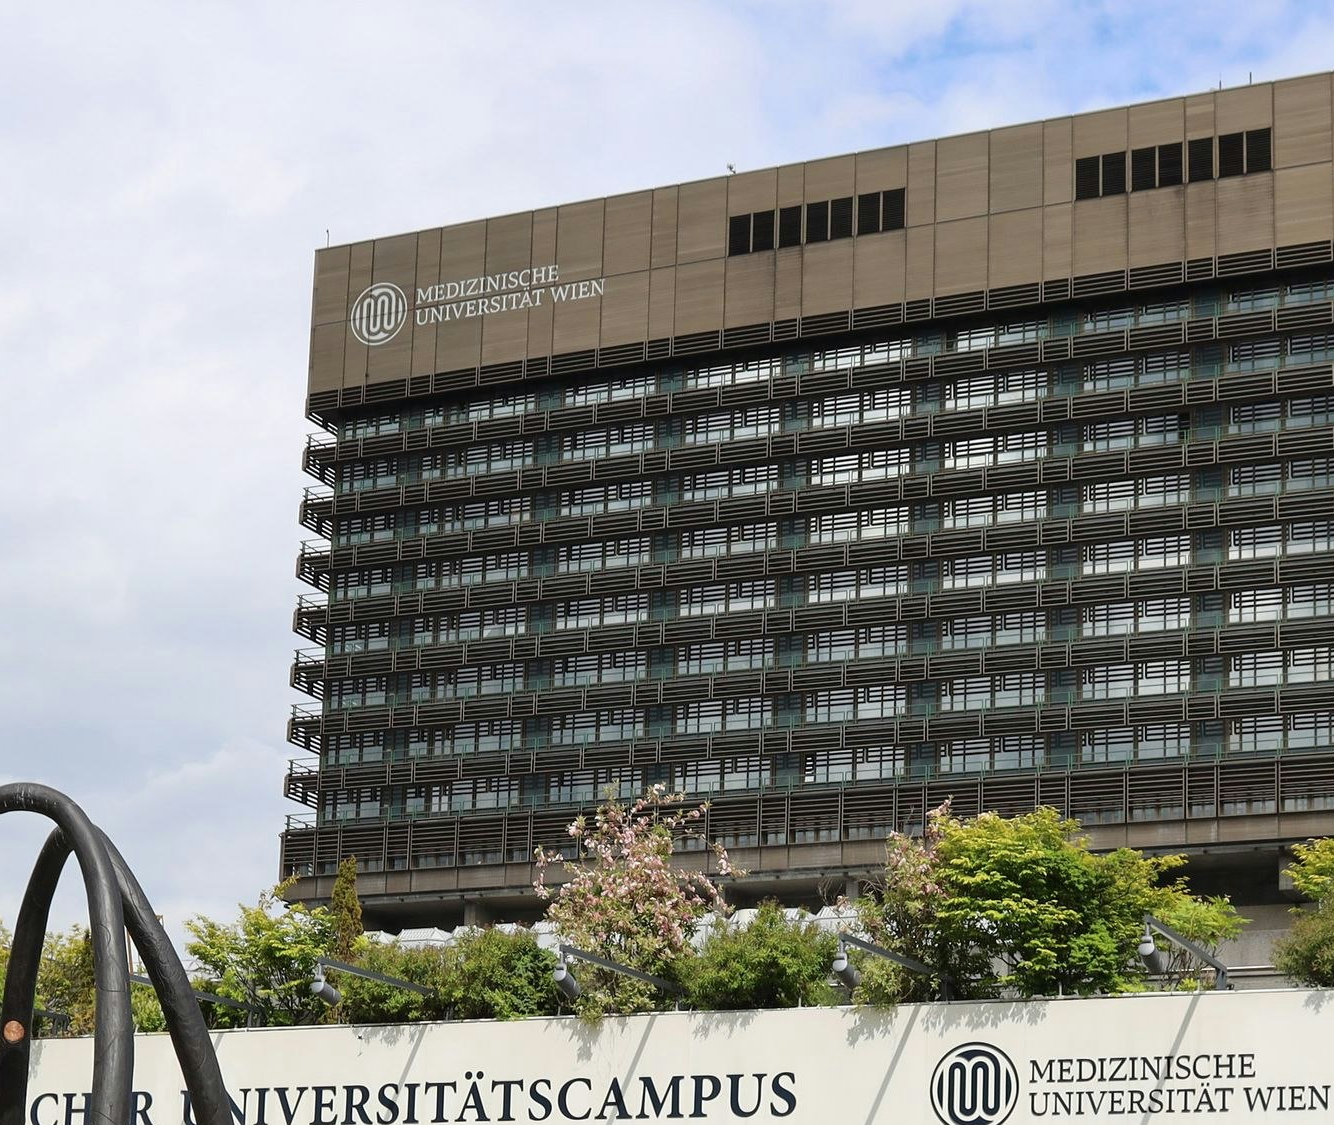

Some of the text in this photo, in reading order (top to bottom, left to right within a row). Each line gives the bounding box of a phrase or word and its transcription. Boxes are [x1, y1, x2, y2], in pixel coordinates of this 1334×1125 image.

[415, 264, 559, 305] MEDIZINISCHE
[416, 278, 606, 325] UNIVERSITÄT WIEN
[1028, 1053, 1257, 1084] MEDIZINISCHE
[1028, 1083, 1332, 1117] UNIVERSITÄT WIEN
